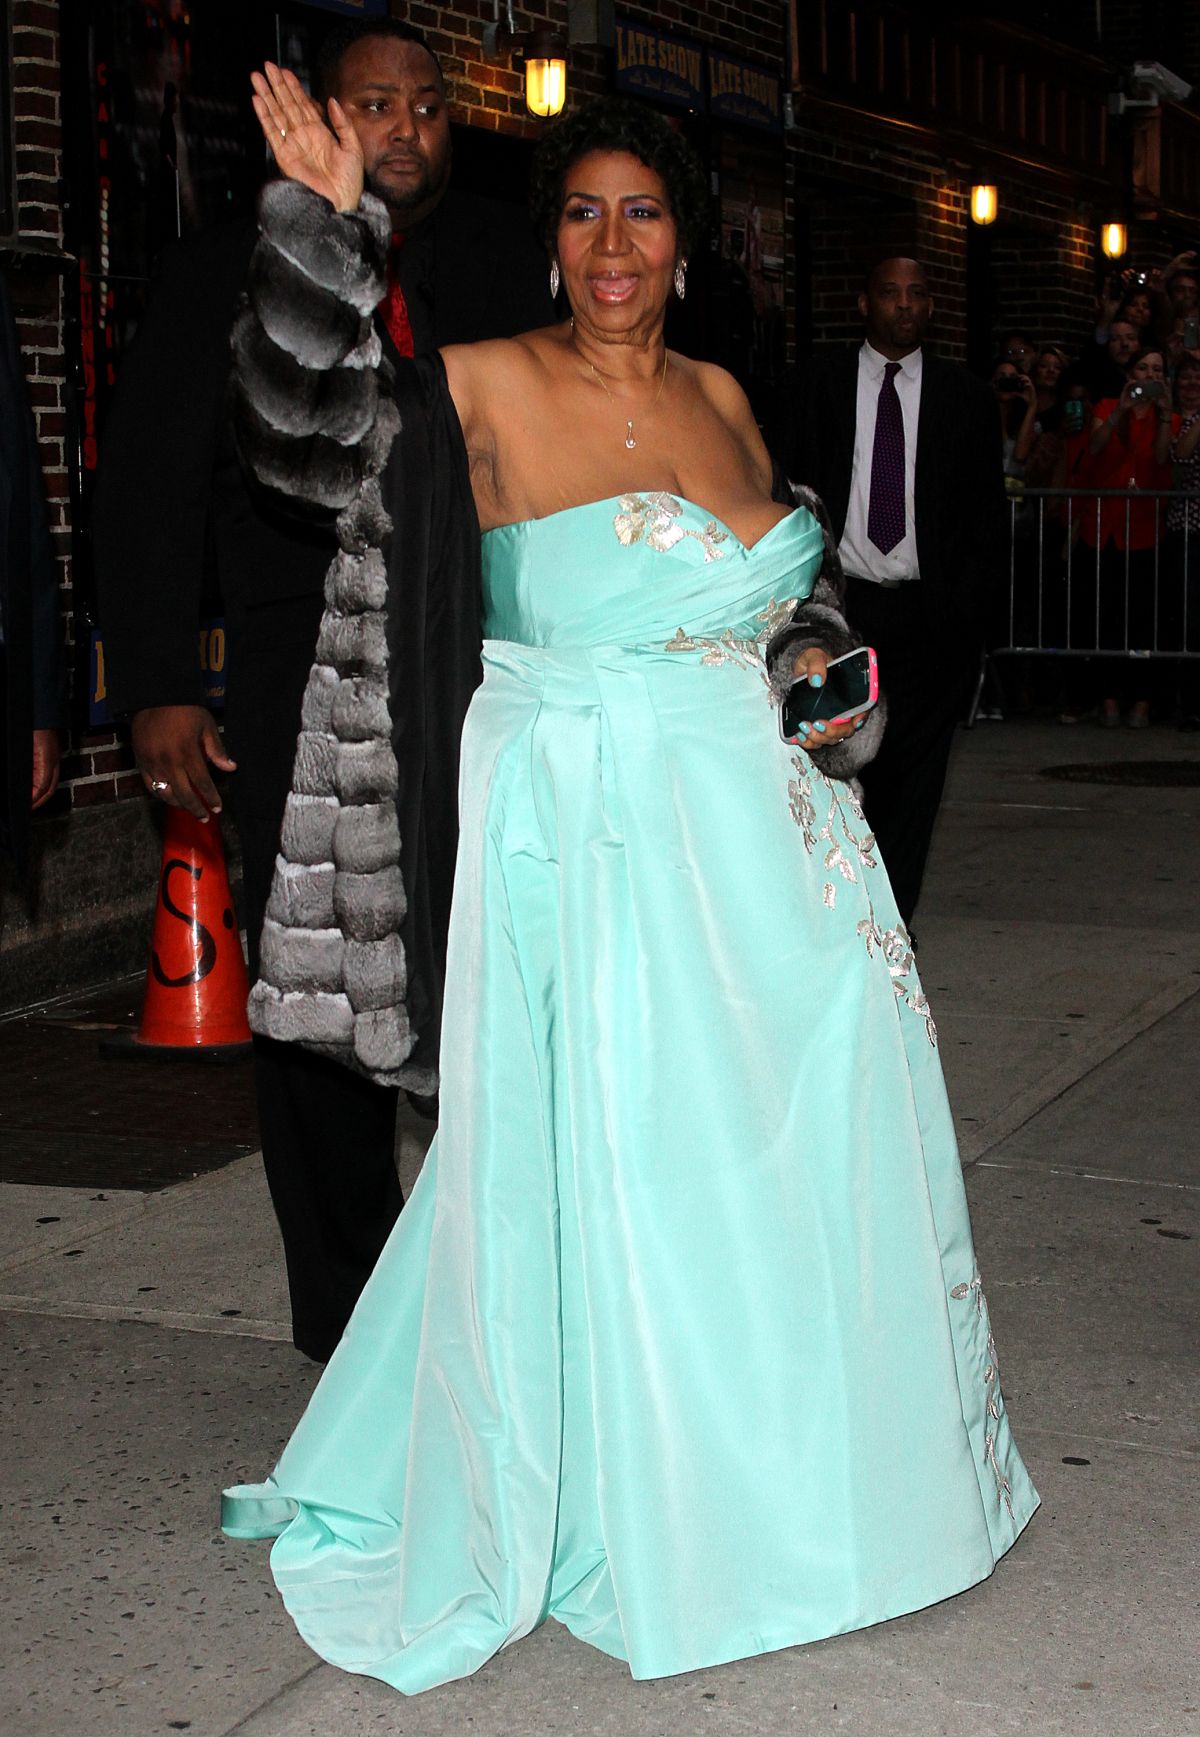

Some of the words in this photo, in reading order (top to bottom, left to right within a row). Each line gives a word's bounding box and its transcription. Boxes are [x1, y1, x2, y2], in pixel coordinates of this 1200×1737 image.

[616, 25, 656, 70] LATE
[658, 39, 702, 92] SHOW
[708, 56, 742, 96] LATE
[743, 68, 779, 116] SHOW
